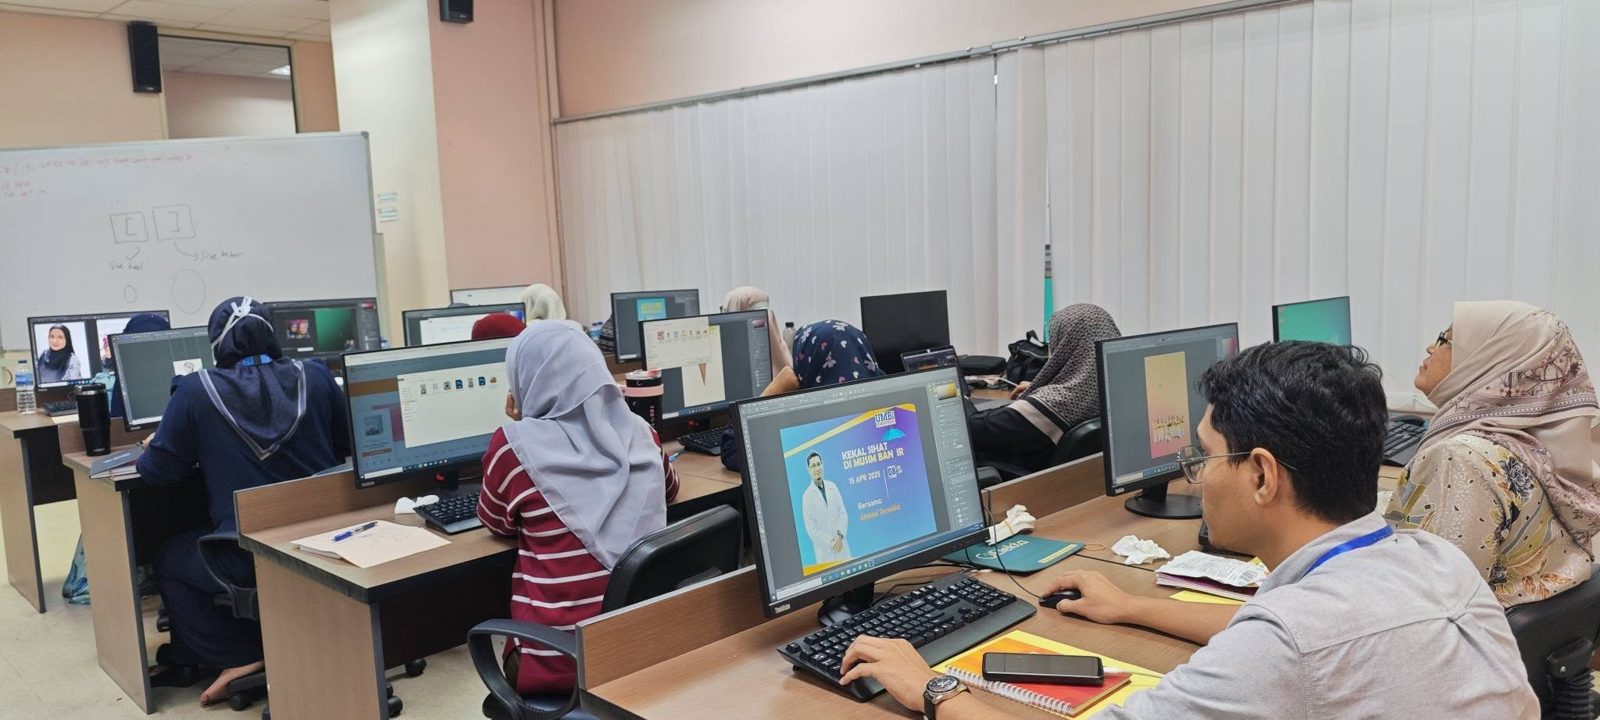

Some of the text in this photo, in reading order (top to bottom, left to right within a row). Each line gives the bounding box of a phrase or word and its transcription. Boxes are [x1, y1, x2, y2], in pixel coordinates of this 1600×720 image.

[841, 442, 888, 460] KEKAL SIHAT
[843, 459, 853, 471] DI
[853, 452, 878, 468] MUSIM
[855, 472, 868, 484] APR
